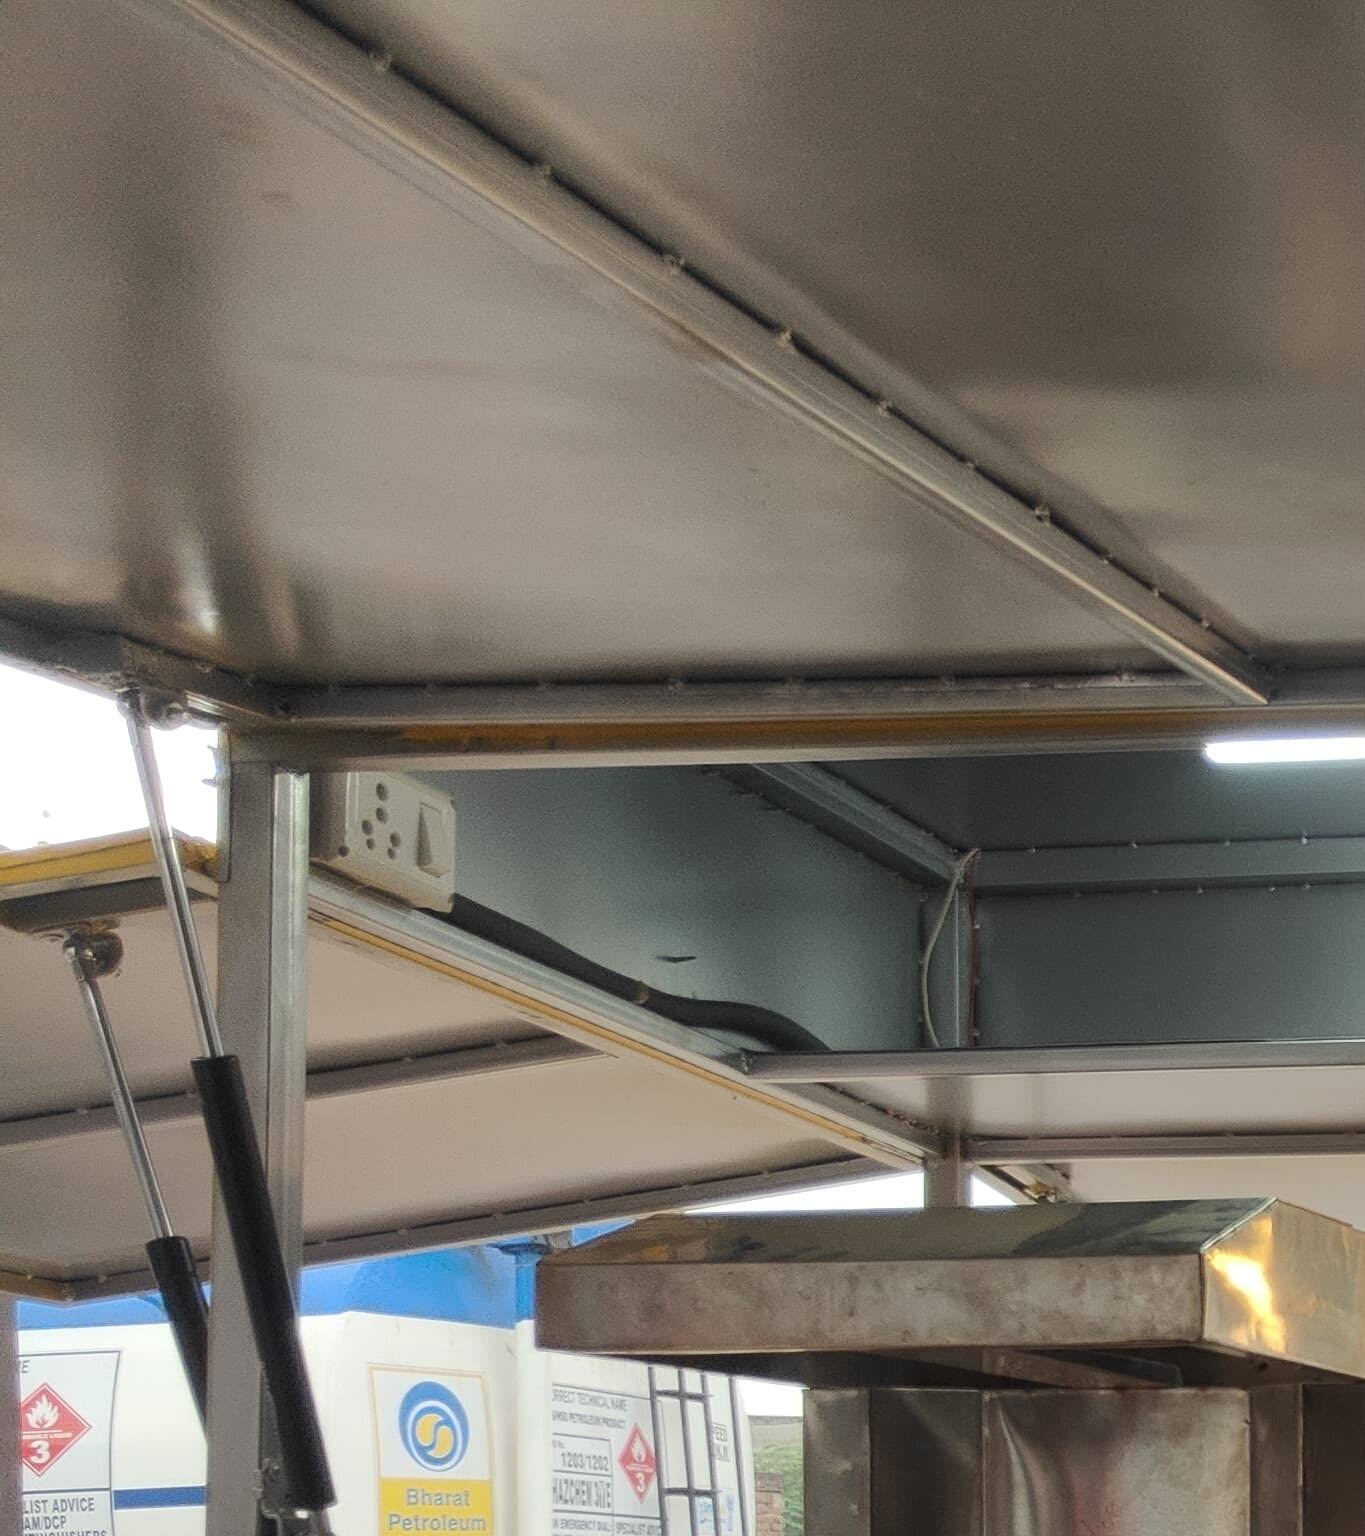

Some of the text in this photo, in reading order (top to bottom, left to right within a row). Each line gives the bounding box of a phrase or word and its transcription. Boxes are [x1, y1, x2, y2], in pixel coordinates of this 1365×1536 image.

[30, 1440, 51, 1464] 3
[635, 1472, 646, 1492] 3
[52, 1497, 95, 1513] ADVICE
[405, 1487, 471, 1507] Bharat
[388, 1513, 487, 1532] Petroleum
